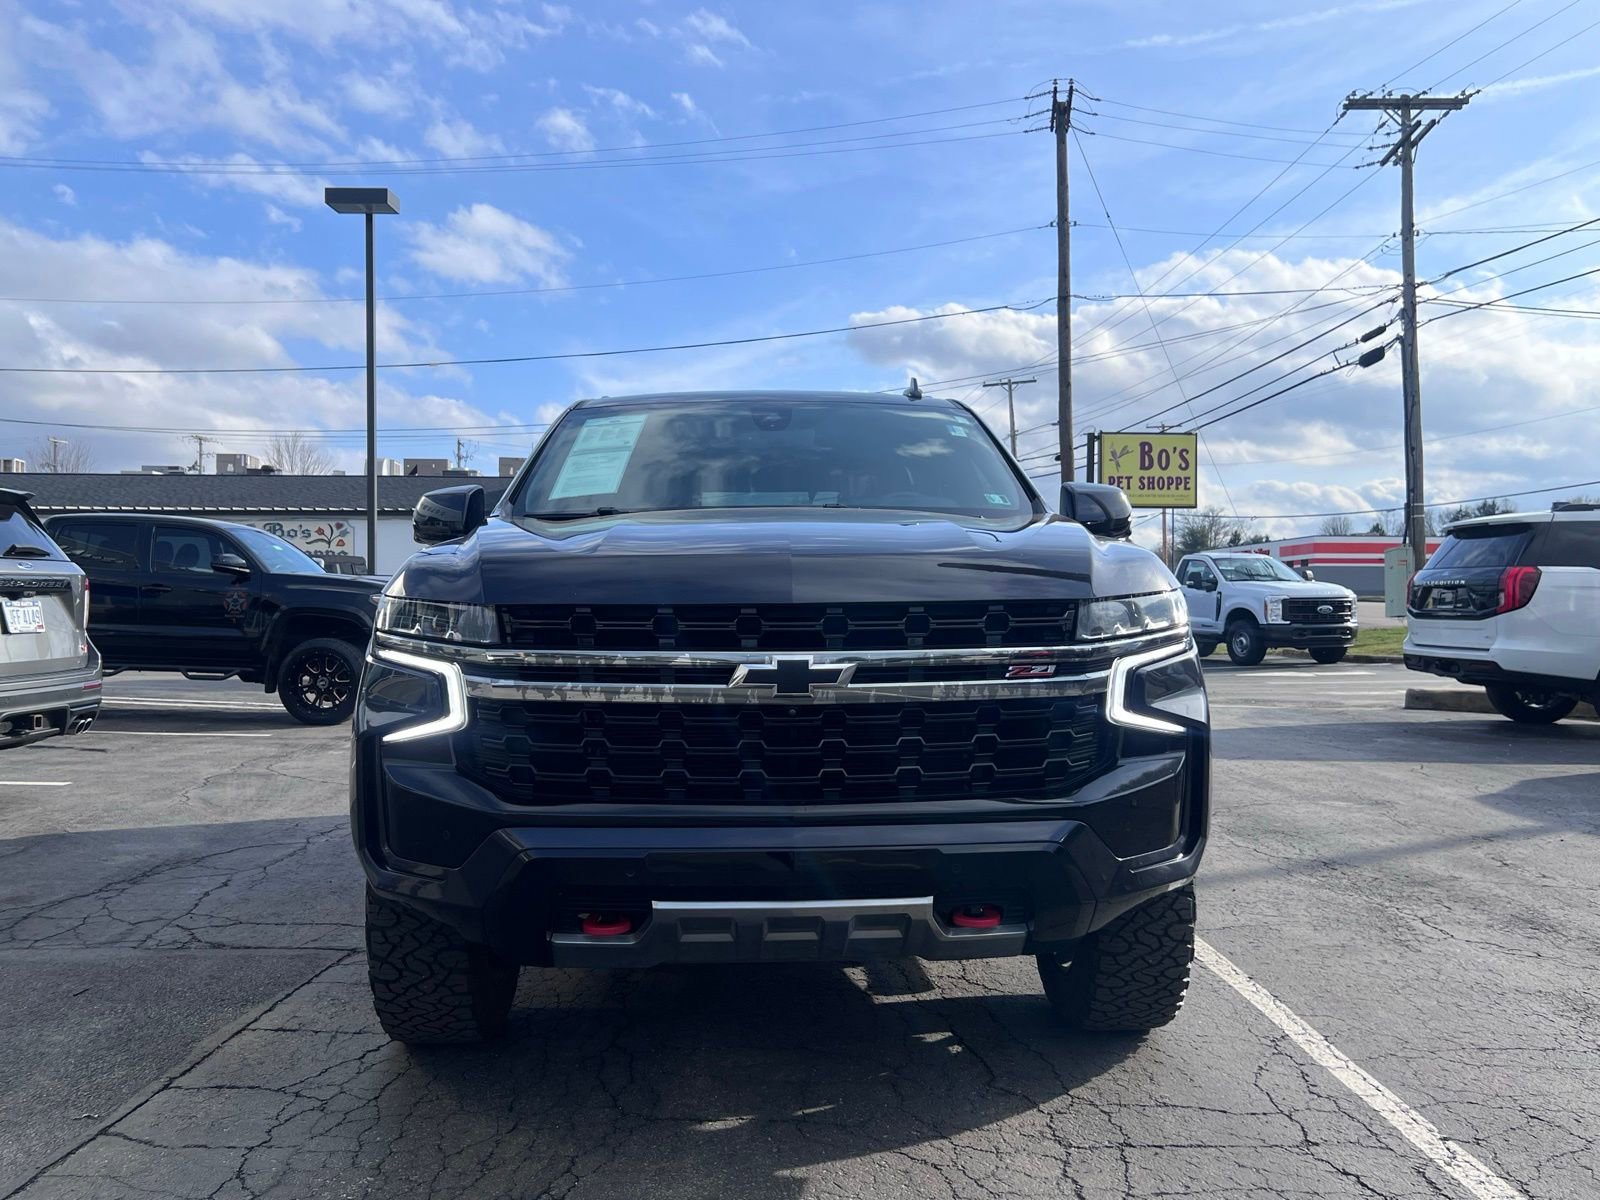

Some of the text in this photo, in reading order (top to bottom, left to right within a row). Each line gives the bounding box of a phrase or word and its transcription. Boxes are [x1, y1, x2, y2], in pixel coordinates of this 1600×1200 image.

[1107, 475, 1191, 491] PET SHOPPE
[1005, 664, 1057, 678] Z71
